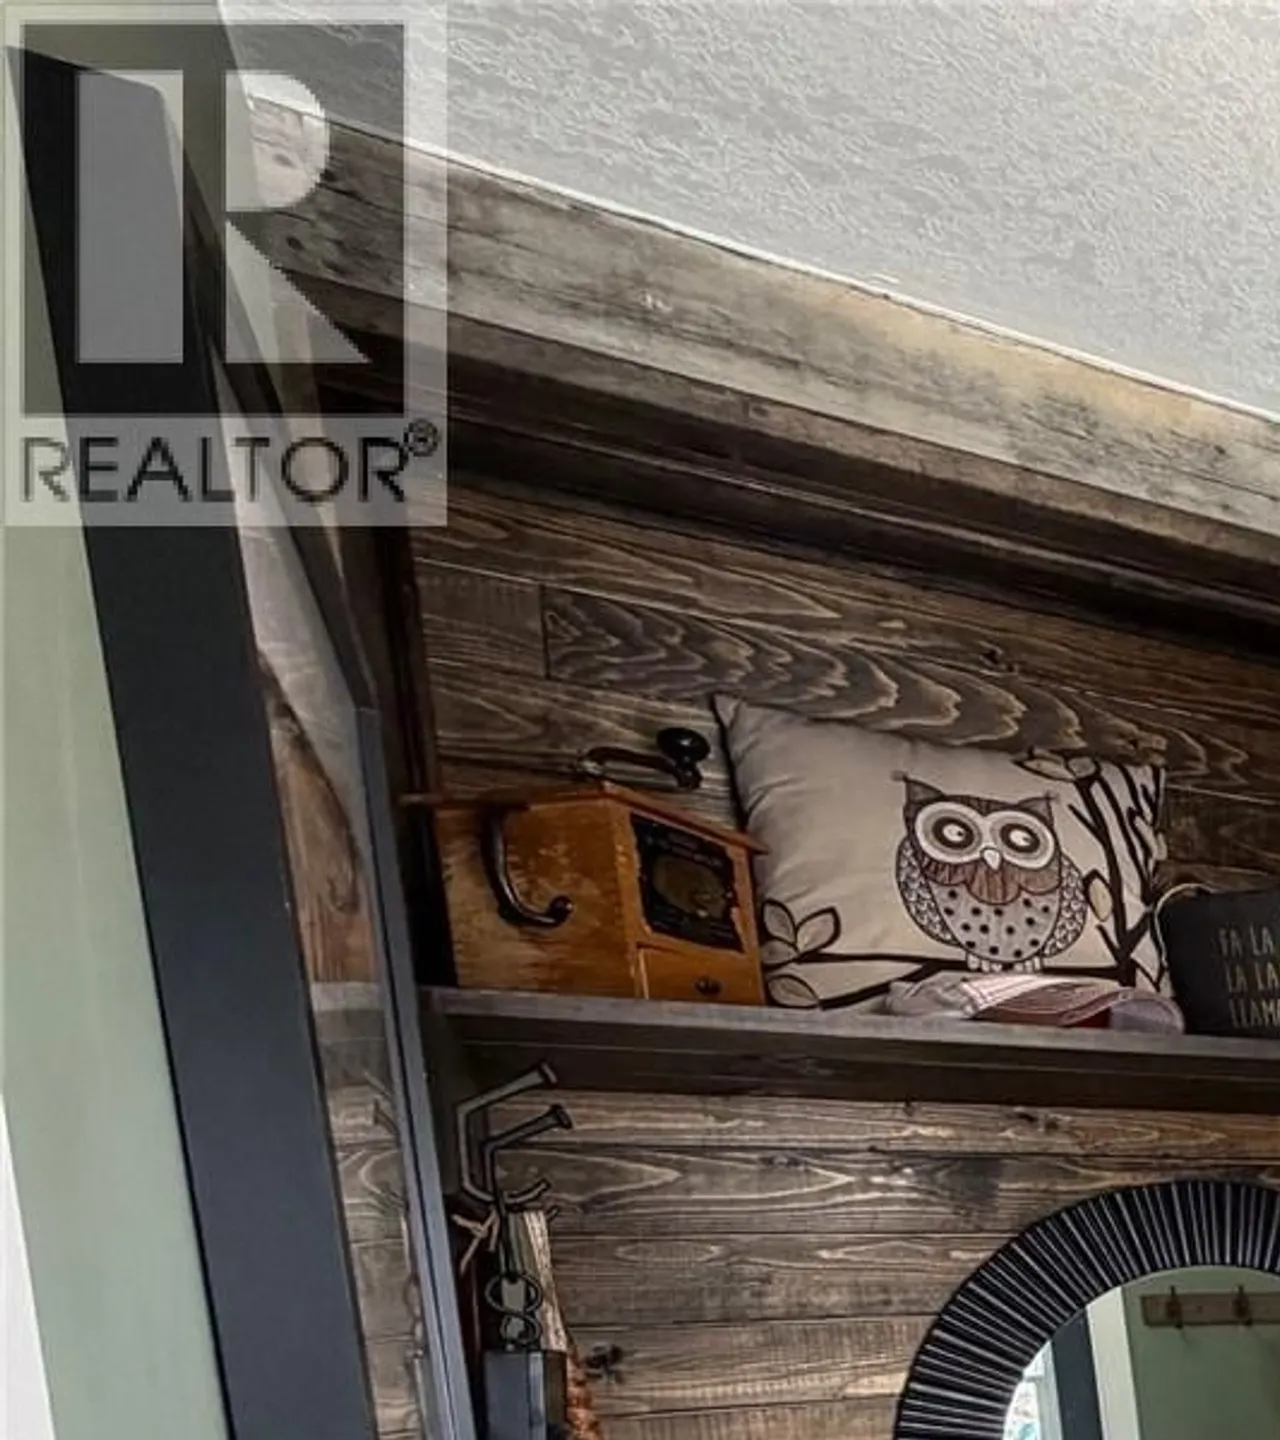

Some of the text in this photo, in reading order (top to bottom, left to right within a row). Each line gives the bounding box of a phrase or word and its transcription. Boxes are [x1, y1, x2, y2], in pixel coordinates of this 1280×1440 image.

[1249, 922, 1274, 956] LA
[1225, 961, 1279, 993] LA LA
